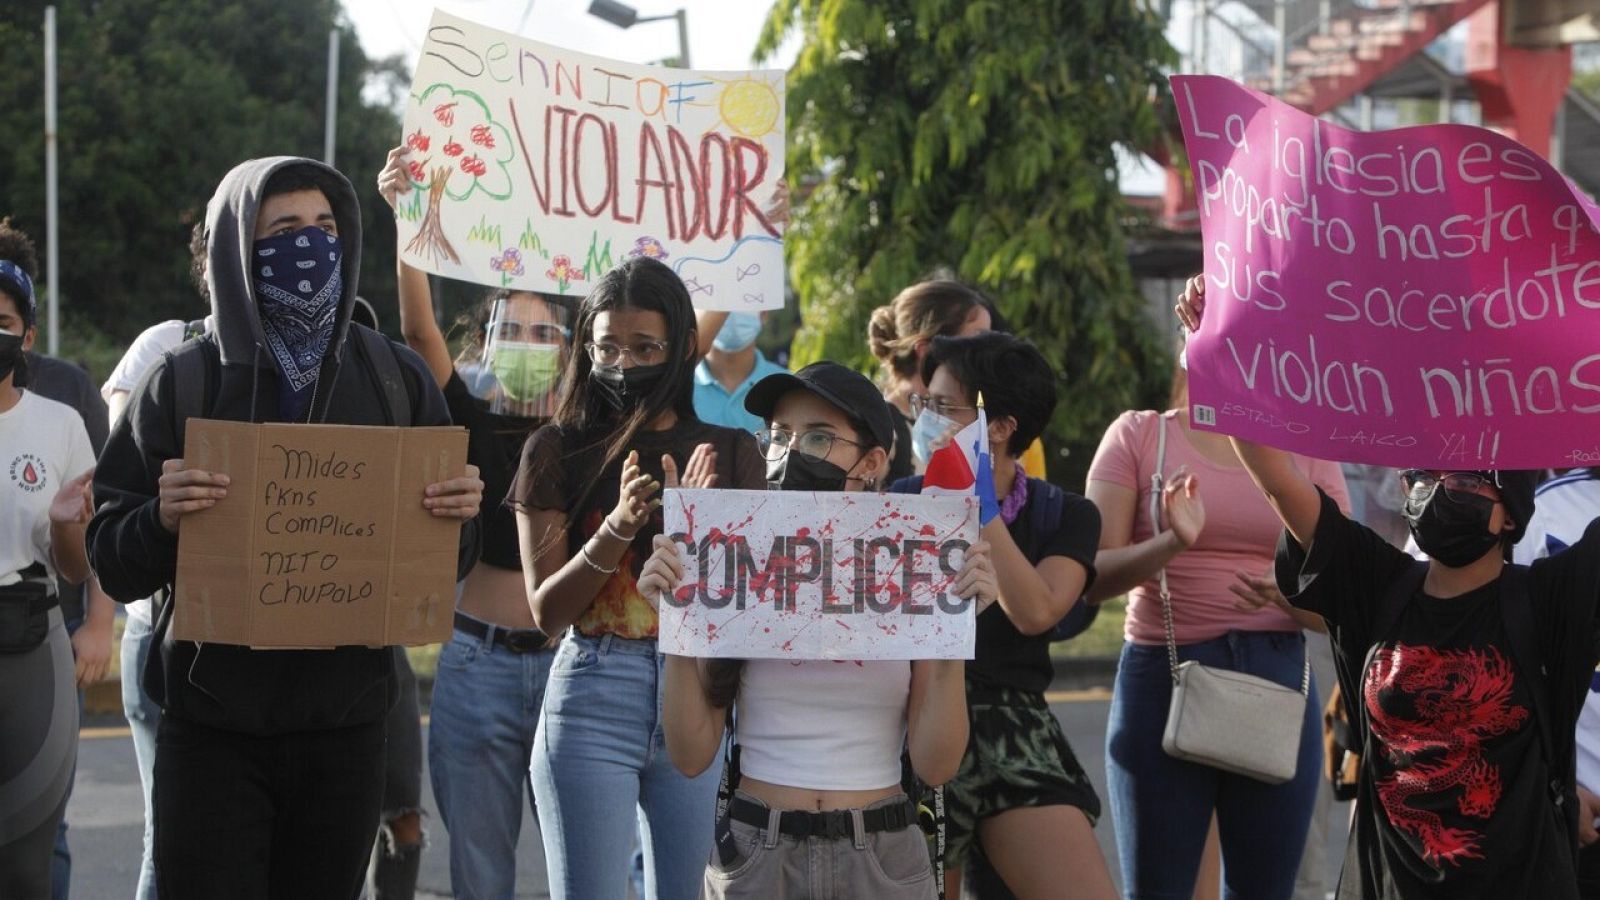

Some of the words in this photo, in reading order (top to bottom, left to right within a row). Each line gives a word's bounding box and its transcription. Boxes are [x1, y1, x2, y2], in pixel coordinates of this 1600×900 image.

[508, 97, 782, 244] VIOLADOR
[1183, 80, 1250, 155] La
[1273, 118, 1446, 206] iglesia
[1457, 141, 1542, 184] es
[1374, 186, 1532, 262] hasta
[1220, 402, 1311, 434] ESTADO
[1226, 334, 1394, 417] violan
[1419, 354, 1600, 418] niñas
[661, 531, 971, 616] COMPLICES
